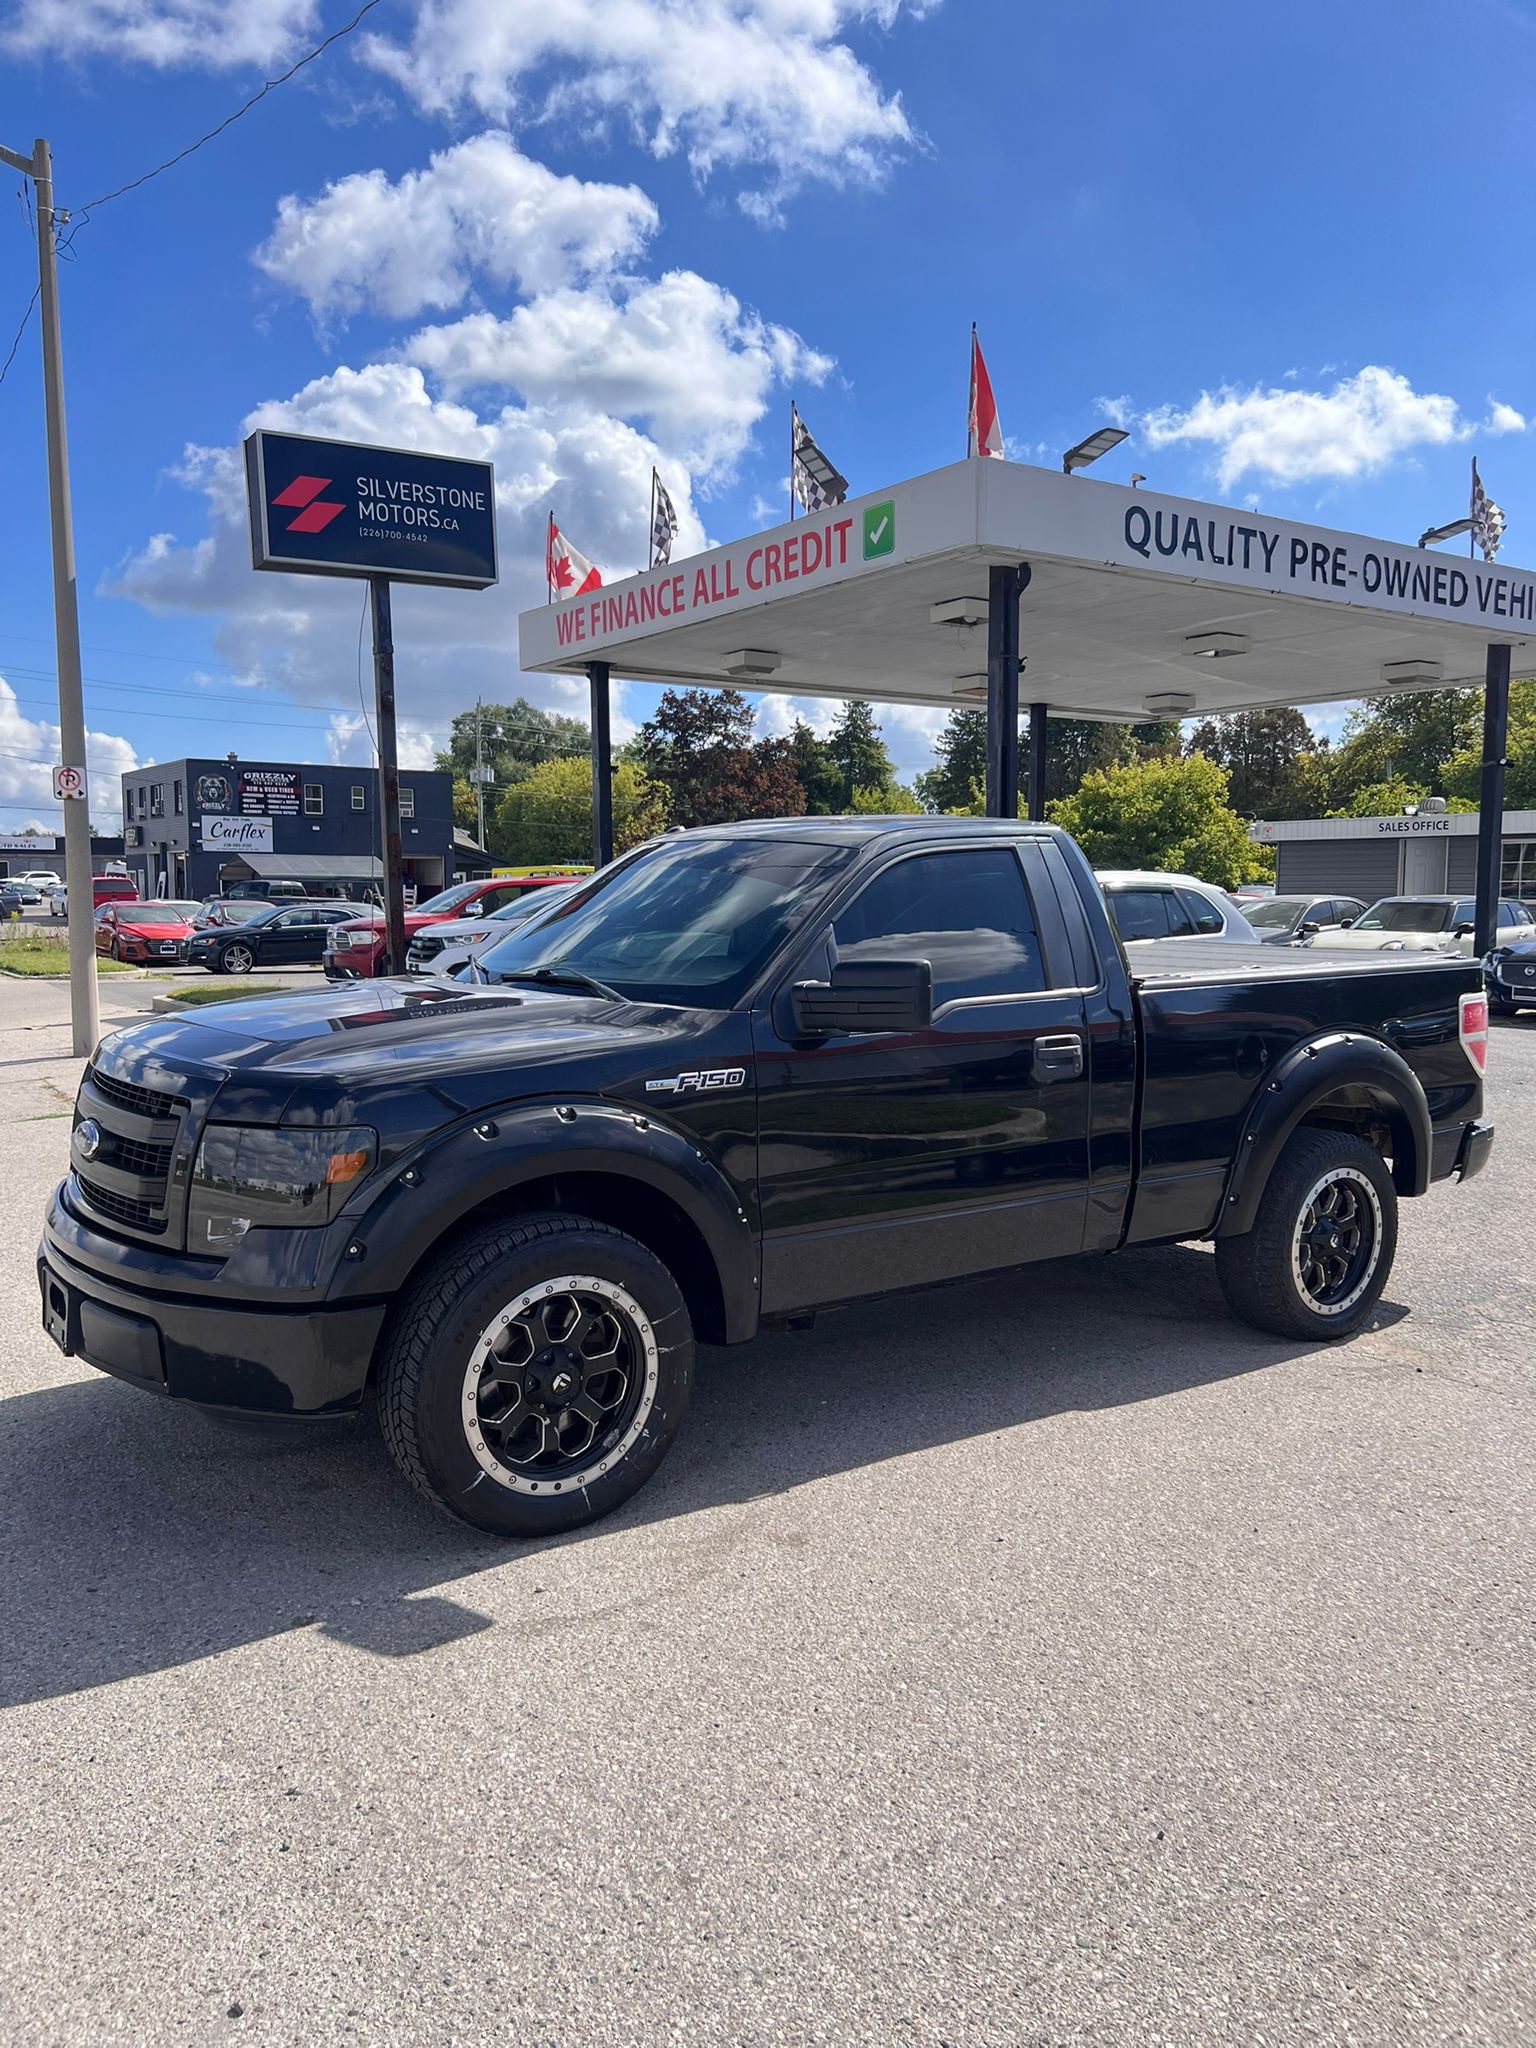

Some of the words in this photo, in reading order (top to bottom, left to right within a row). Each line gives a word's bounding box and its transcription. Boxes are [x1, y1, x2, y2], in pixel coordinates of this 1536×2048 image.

[356, 476, 486, 511] SILVERSTONE
[1124, 505, 1280, 574] QUALITY
[1289, 537, 1469, 608] PRE-OWNED
[555, 607, 586, 647] WE
[590, 575, 686, 638] FINANCE
[692, 559, 740, 610] ALL
[745, 518, 854, 592] CREDIT
[243, 771, 297, 781] GRIZZLY
[210, 821, 266, 842] Carflex
[1378, 822, 1410, 832] SALES
[1412, 820, 1449, 831] OFFICE
[673, 1067, 746, 1094] F-150
